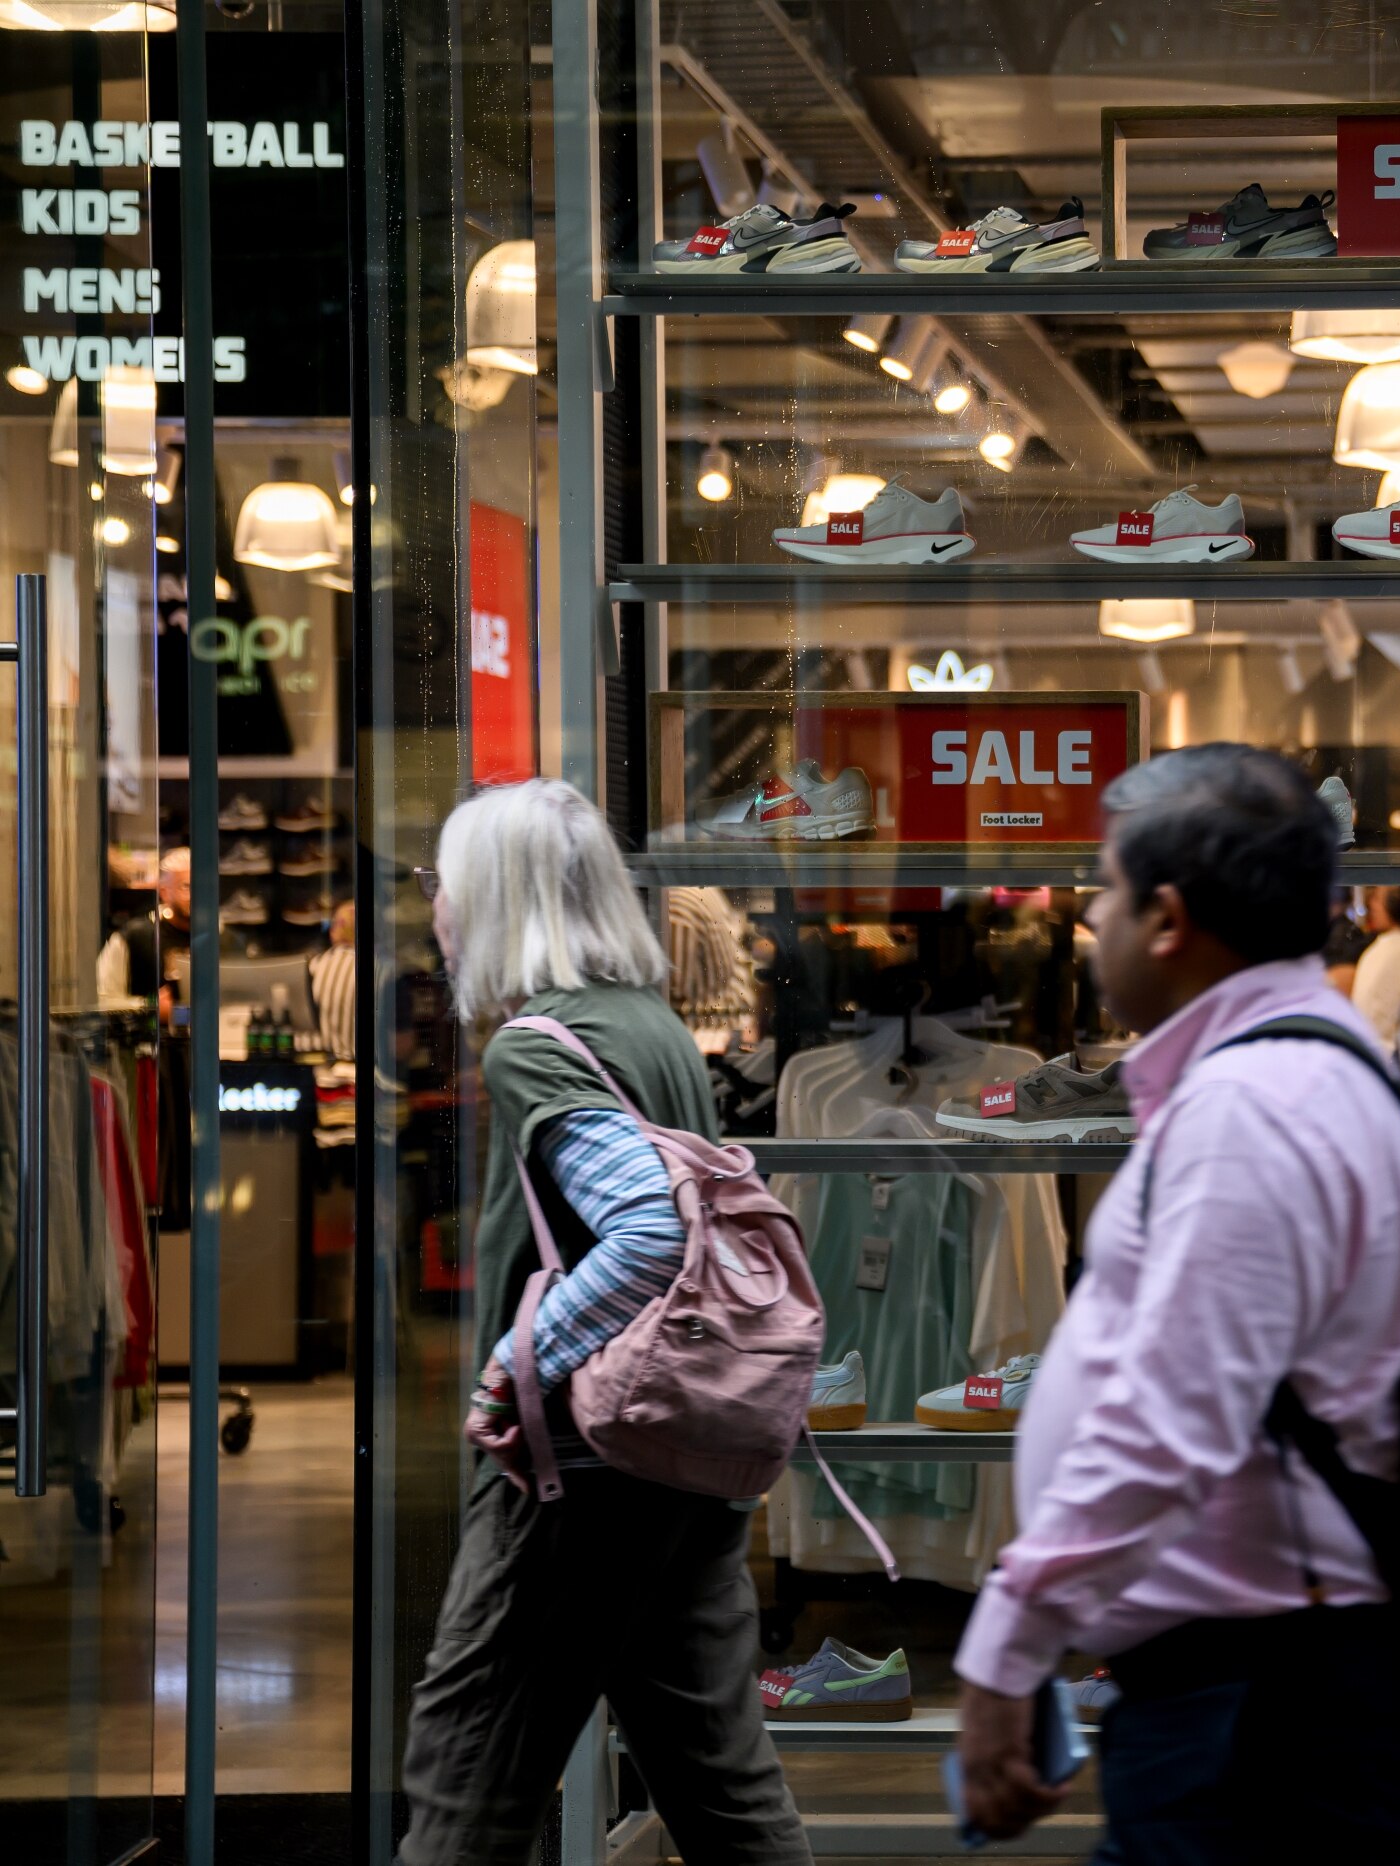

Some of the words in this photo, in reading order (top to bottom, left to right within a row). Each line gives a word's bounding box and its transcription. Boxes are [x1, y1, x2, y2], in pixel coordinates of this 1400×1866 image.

[20, 119, 345, 168] BASKEBALL
[21, 189, 140, 235] KIDS
[1191, 223, 1222, 234] SALE
[694, 234, 723, 247] SALE
[941, 237, 971, 248] SALE
[23, 266, 161, 314] MENS
[22, 335, 248, 383] WOMES
[830, 522, 860, 535] SALE
[1120, 523, 1150, 536] SALE
[931, 730, 1093, 785] SALE
[983, 815, 1005, 825] Foot
[1007, 815, 1040, 825] Locker
[984, 1092, 1012, 1107] SALE
[968, 1386, 998, 1398] SALE
[759, 1680, 785, 1697] SALE
